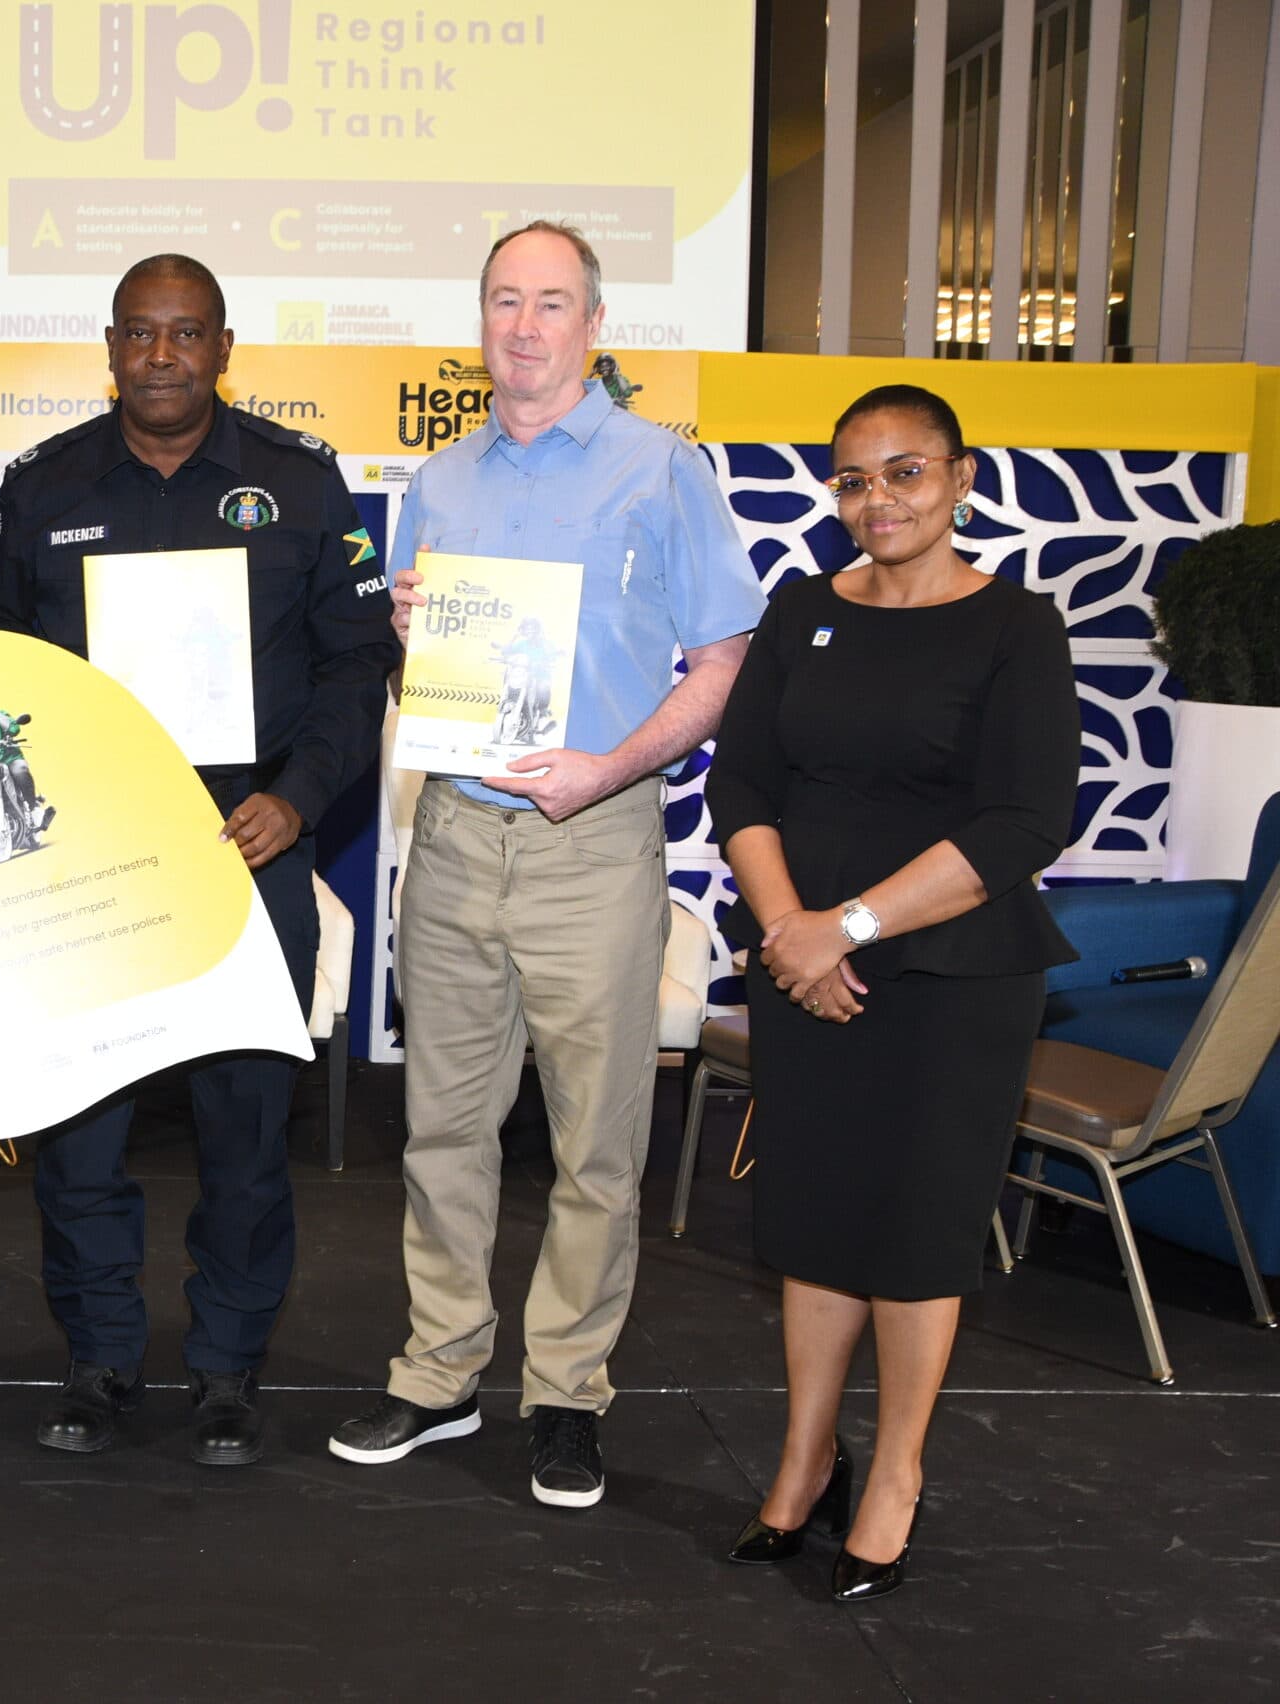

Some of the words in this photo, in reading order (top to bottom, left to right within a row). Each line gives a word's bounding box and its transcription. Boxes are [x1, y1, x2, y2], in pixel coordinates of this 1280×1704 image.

[315, 10, 544, 53] Regional
[19, 0, 293, 160] Up!
[315, 58, 457, 91] Think
[314, 108, 437, 138] Tank
[76, 205, 138, 217] Advocate
[141, 205, 180, 219] boldly
[184, 205, 203, 217] for
[315, 203, 392, 216] Collaborate
[32, 207, 64, 249] A
[76, 223, 179, 235] standardisation
[183, 223, 208, 234] and
[269, 207, 302, 252] C
[384, 222, 404, 233] for
[582, 229, 604, 241] afe
[75, 240, 123, 255] testing
[327, 303, 391, 319] JAMAICA
[283, 319, 316, 342] AA
[327, 321, 414, 337] AUTOMOBILE
[596, 323, 684, 346] DATION
[399, 382, 494, 414] Hea
[399, 413, 462, 452] Up!
[51, 525, 105, 546] MCKENZIE
[355, 575, 388, 598] POLI
[426, 592, 513, 619] Heads
[425, 614, 468, 639] Up!
[1, 873, 93, 908] standardisation
[94, 865, 118, 881] and
[118, 854, 160, 874] testing
[31, 910, 74, 933] greater
[75, 896, 118, 917] impact
[65, 930, 107, 951] helmet
[108, 924, 130, 939] use
[131, 911, 173, 935] polices
